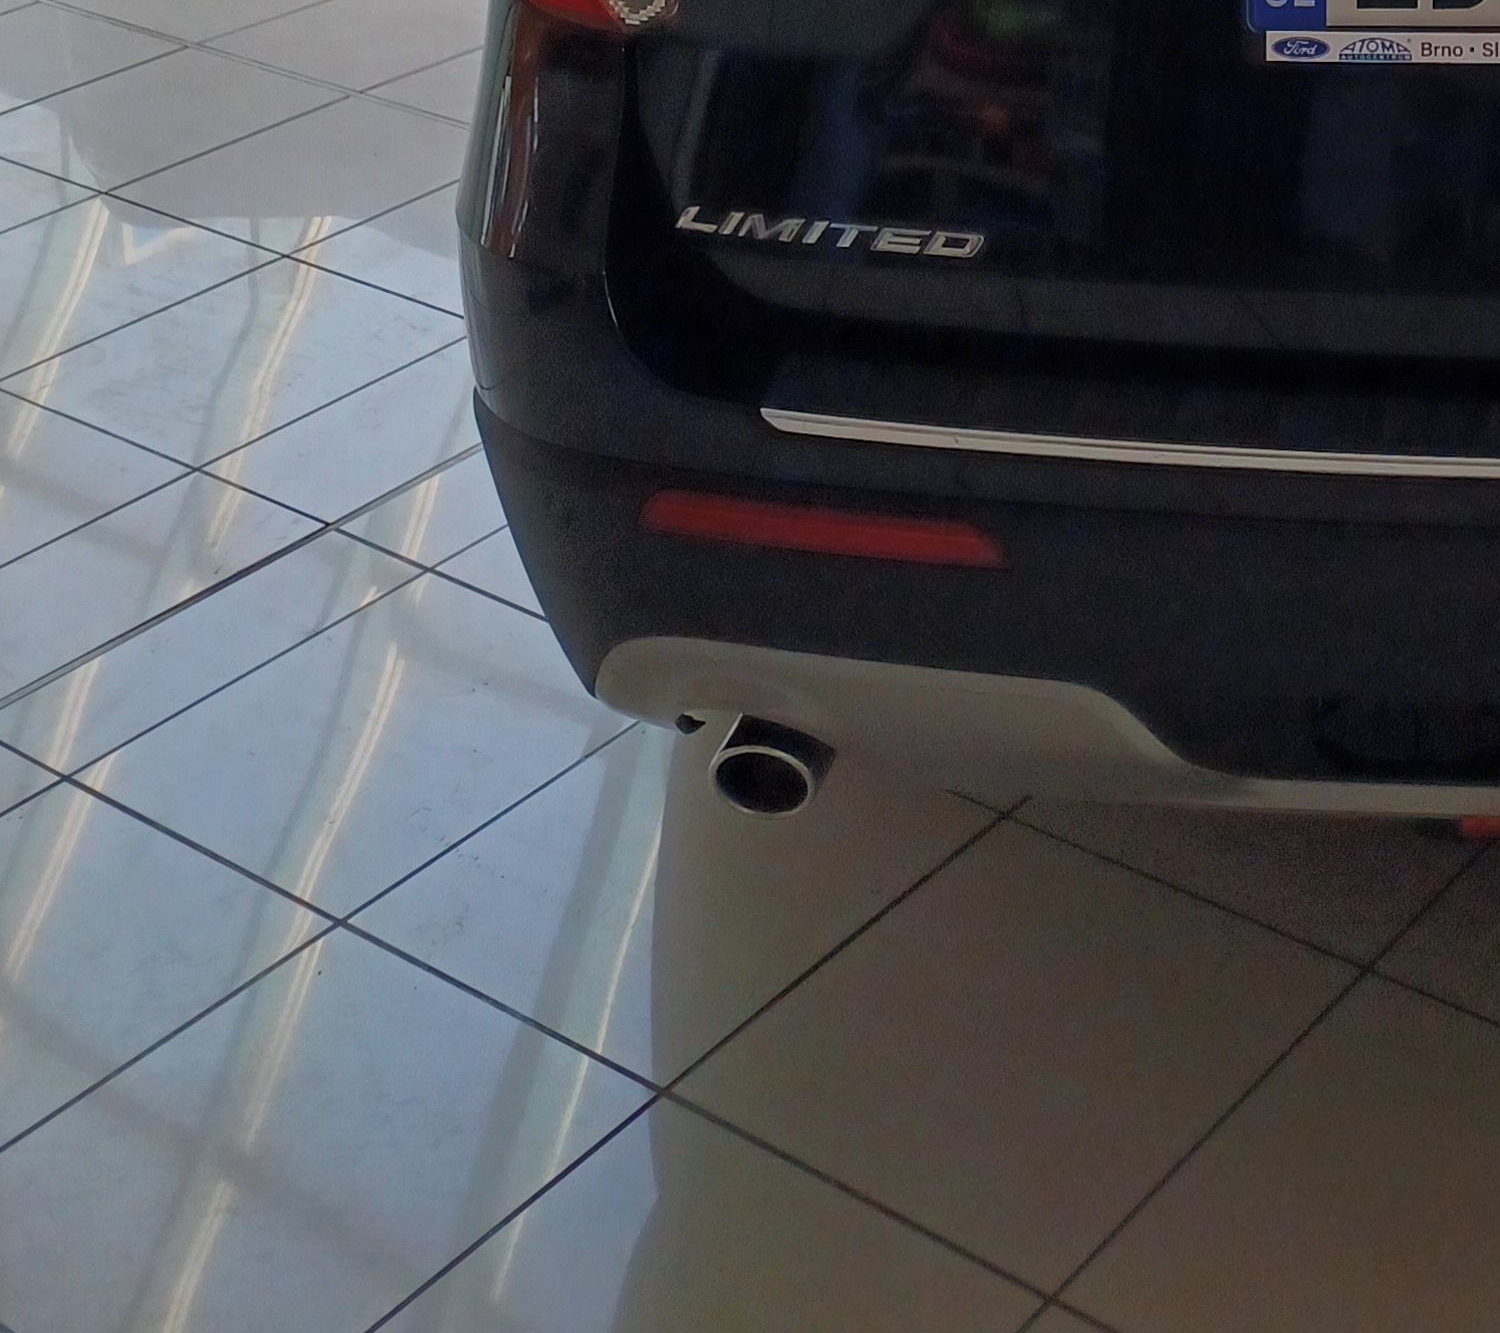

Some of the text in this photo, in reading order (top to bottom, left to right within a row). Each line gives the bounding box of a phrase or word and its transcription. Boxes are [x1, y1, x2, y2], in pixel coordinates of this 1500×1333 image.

[1340, 37, 1412, 54] ATOMA
[1421, 41, 1464, 58] Brno
[675, 206, 985, 258] LIMITED
